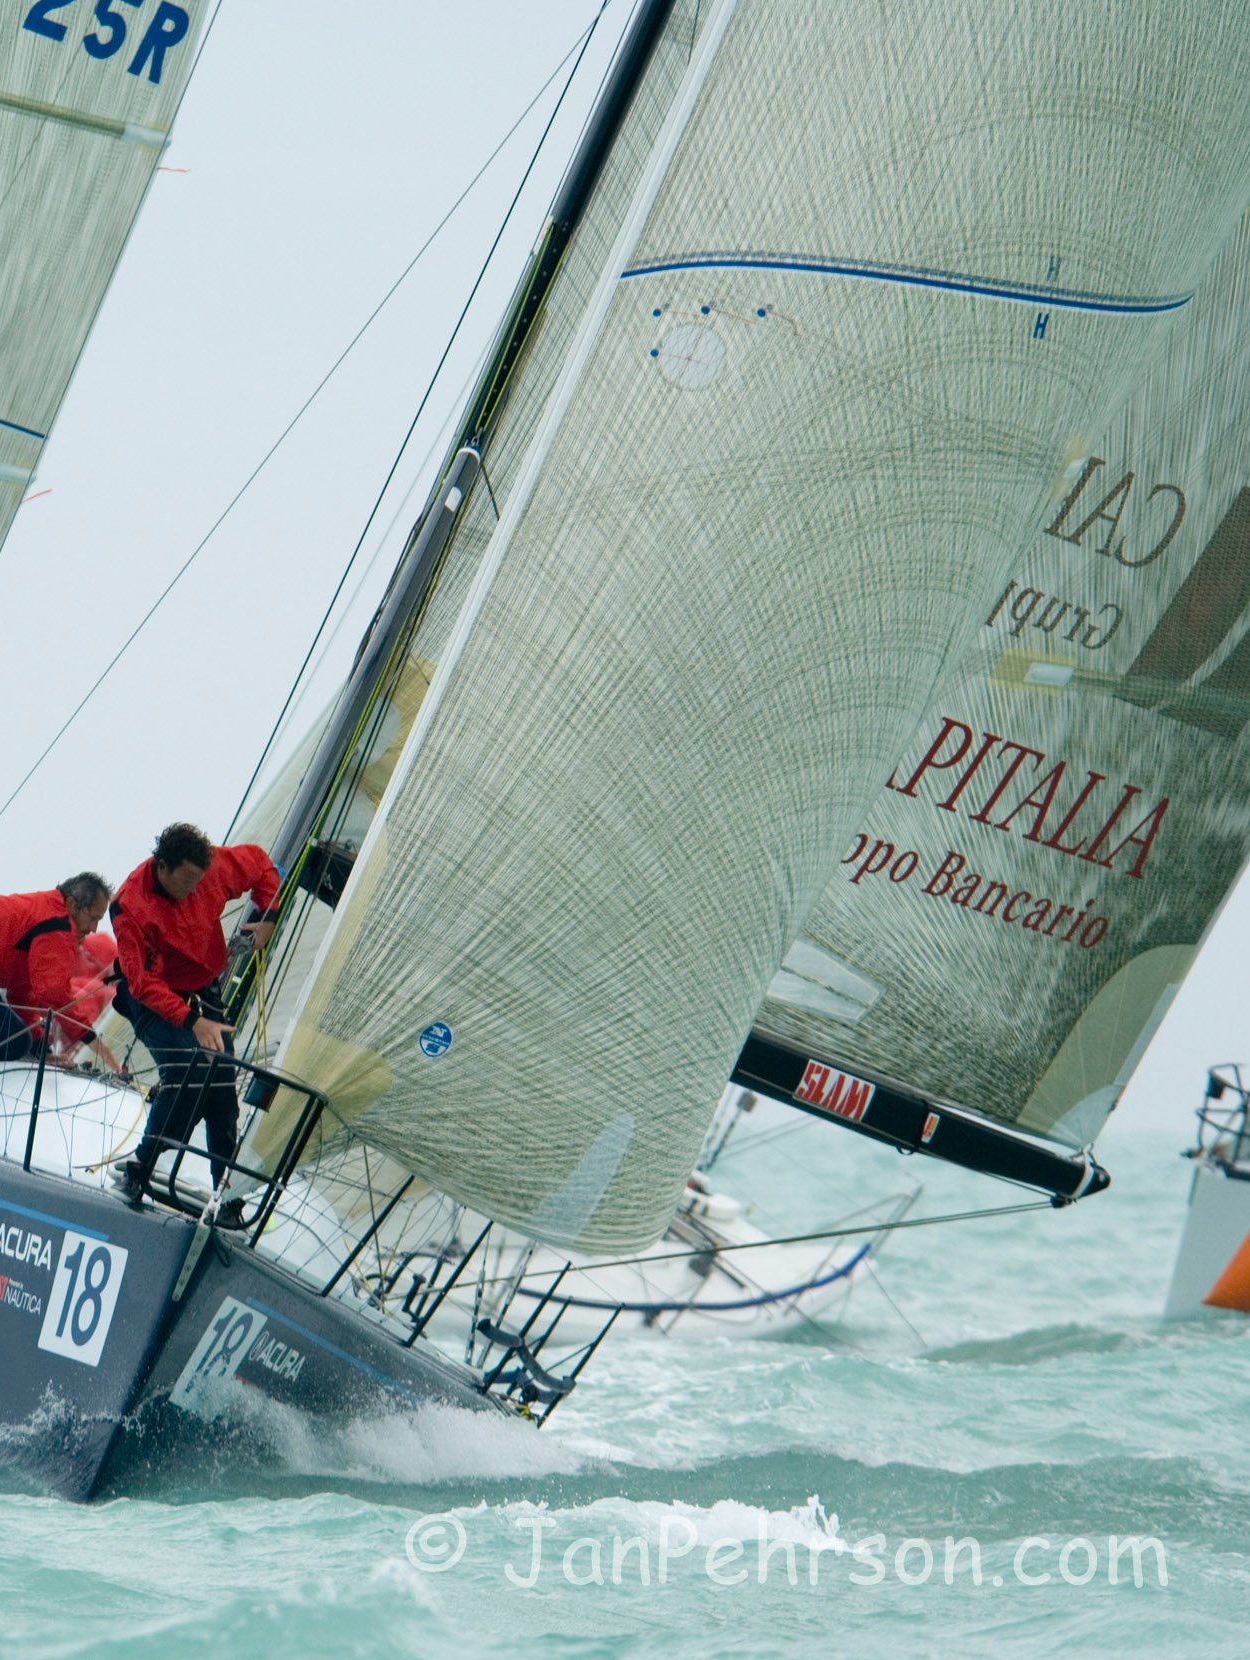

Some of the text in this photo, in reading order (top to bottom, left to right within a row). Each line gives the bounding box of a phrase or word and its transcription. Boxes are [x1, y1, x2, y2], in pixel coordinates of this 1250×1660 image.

[23, 0, 190, 84] 25R
[1033, 313, 1049, 339] H
[886, 716, 1170, 880] PITALIA
[921, 851, 1110, 948] Bancario
[795, 1062, 871, 1121] SLAM
[3, 1286, 42, 1315] NAUTICA
[55, 1240, 112, 1346] 18
[257, 1338, 306, 1382] ACURA
